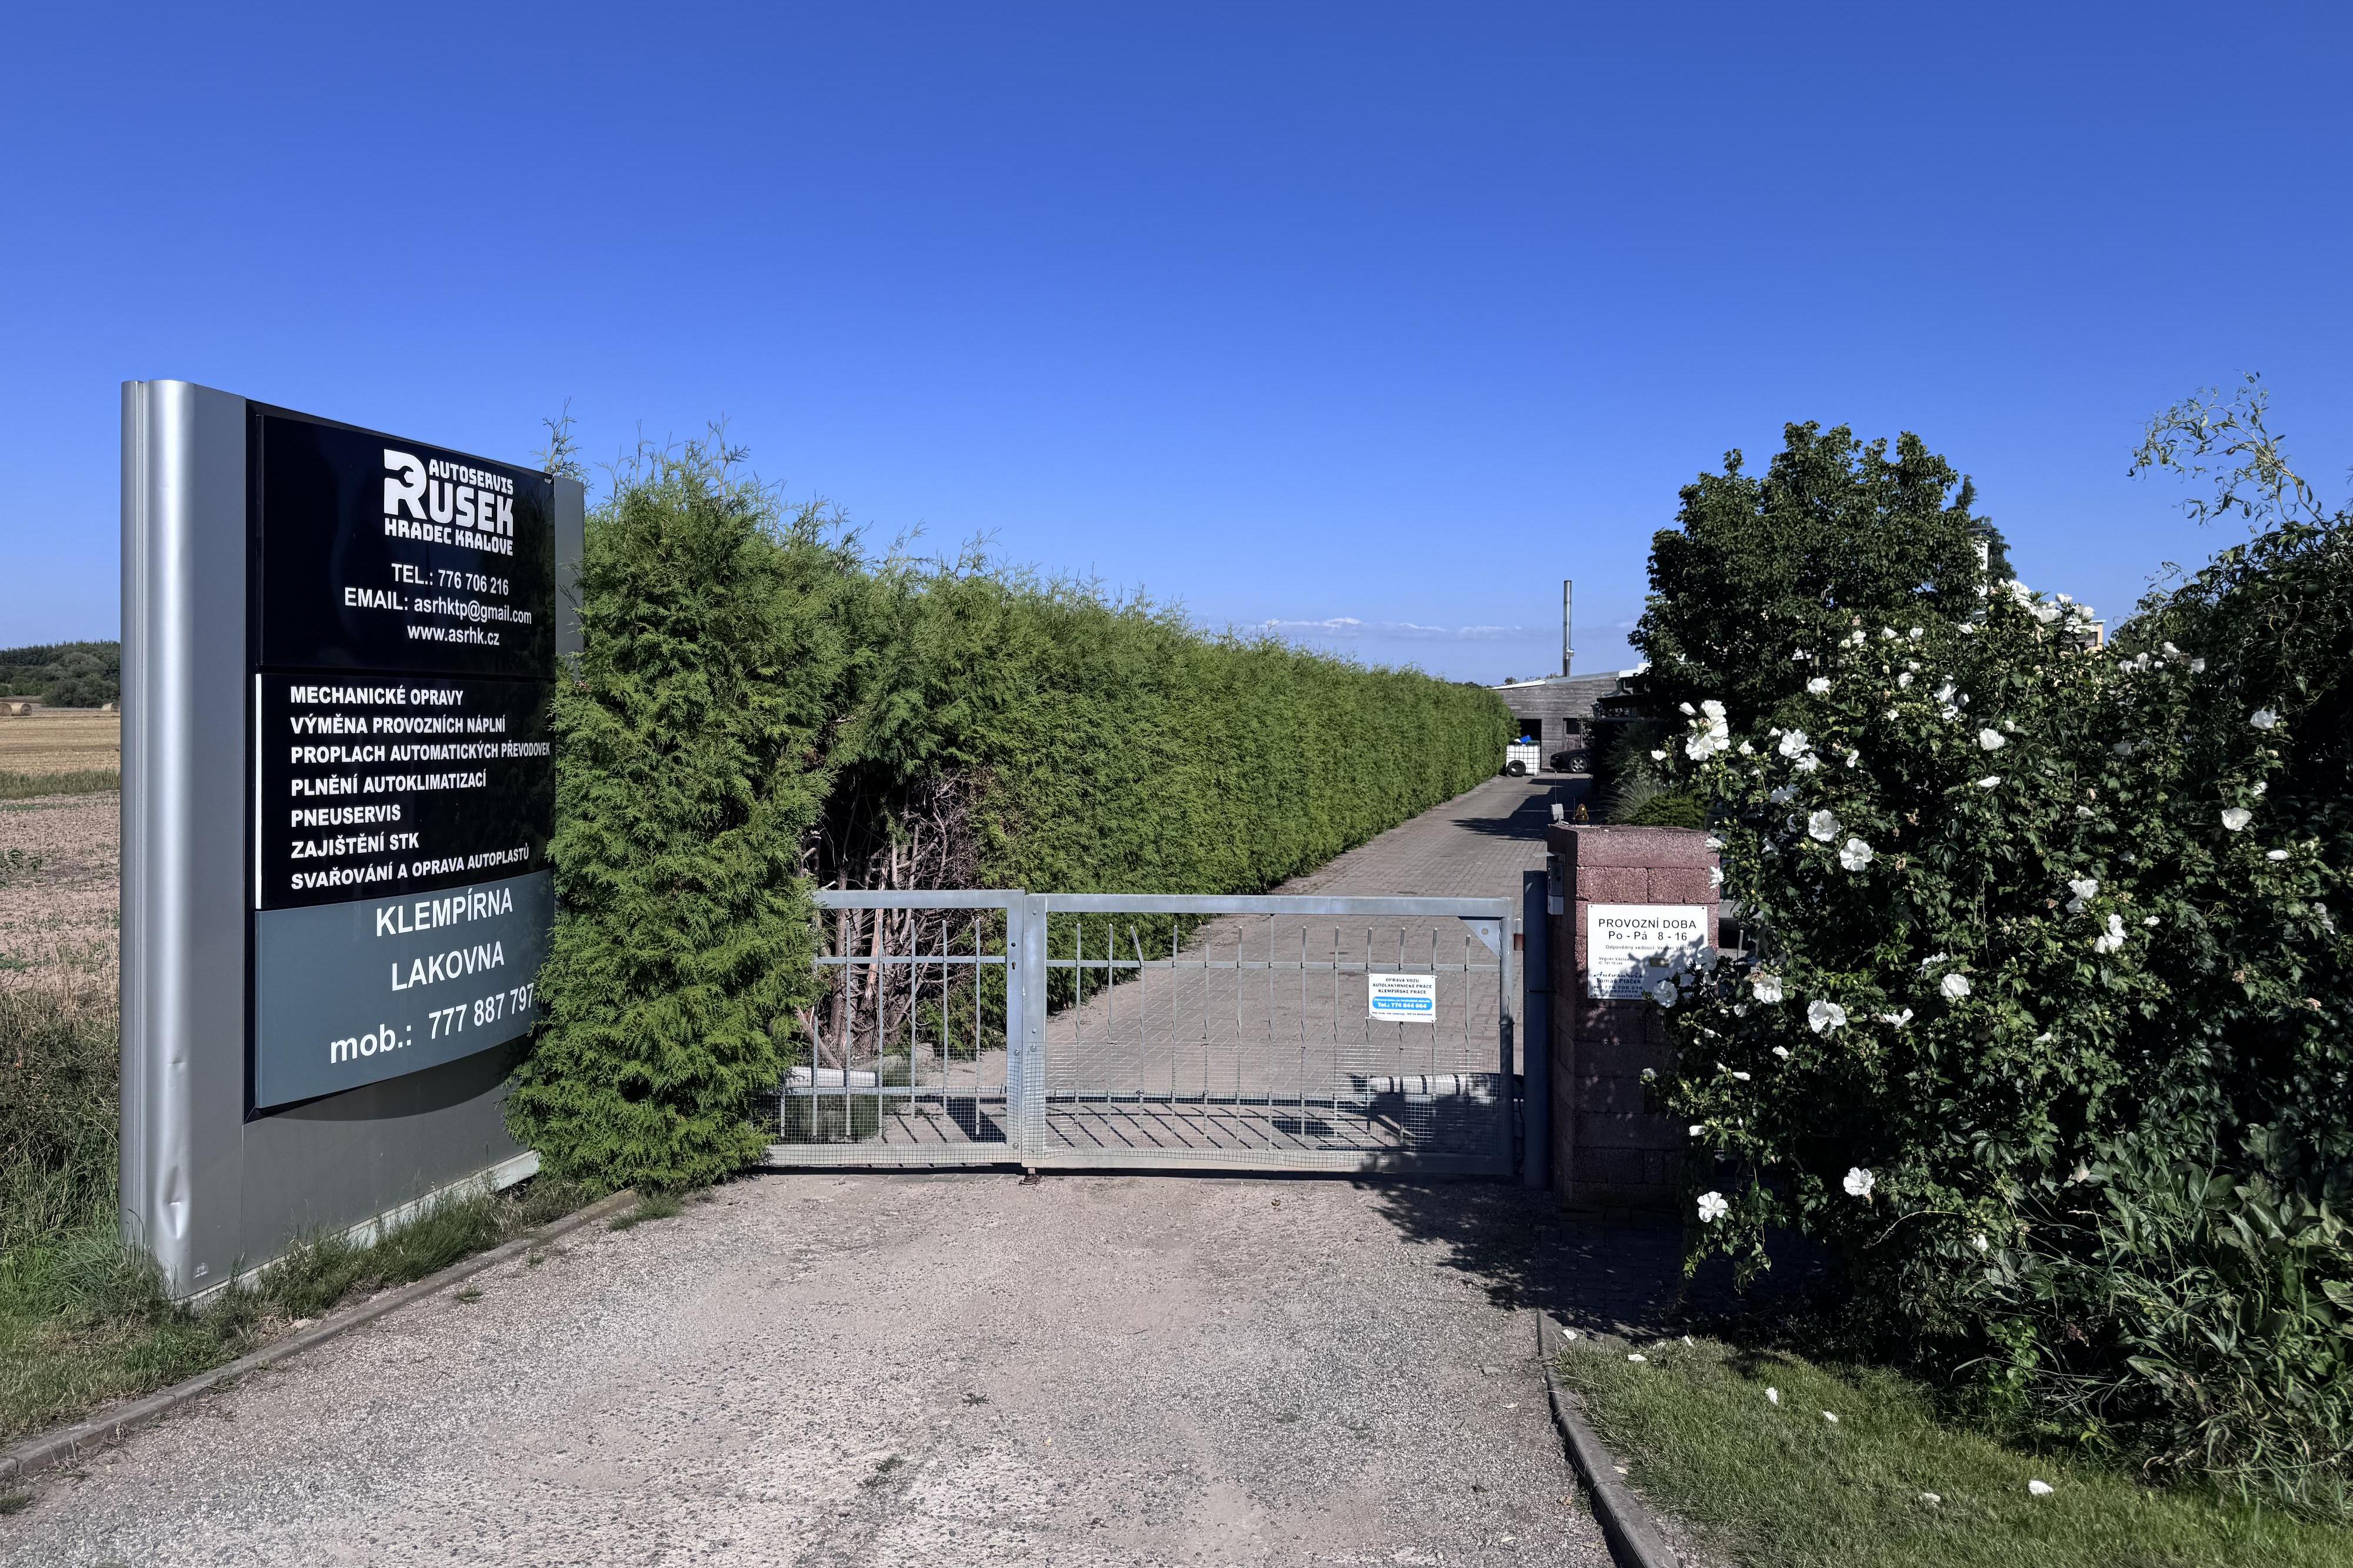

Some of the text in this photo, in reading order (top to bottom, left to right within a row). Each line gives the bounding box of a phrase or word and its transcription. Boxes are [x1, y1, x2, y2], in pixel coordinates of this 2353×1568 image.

[429, 459, 513, 495] AUTOSERVIS
[384, 449, 514, 536] RUSEK
[384, 518, 513, 556] HRADEC KRALOVE
[391, 563, 509, 596] TEL.: 776 706 216
[345, 587, 532, 624] EMAIL: asrhktp@gmail.com
[407, 625, 499, 646] www.asrhk.cz
[291, 685, 464, 705] MECHANICKÉ OPRAVY
[290, 713, 505, 734] VÝMĚNA PROVOZNÍCH NÁPLNÍ
[291, 740, 550, 764] PROPLACH AUTOMATICKÝCH PŘEVODOVEK
[291, 769, 487, 796] PLNĚNÍ AUTOKLIMATIZACÍ
[291, 804, 401, 827] PNEUSERVIS
[291, 832, 419, 859] ZAJIŠTĚNÍ STK
[291, 846, 529, 890] SVAŘOVÁNÍ A OPRAVA AUTOPLASTŮ
[376, 888, 513, 937] KLEMPÍRNA
[1599, 918, 1697, 929] PROVOZNÍ DOBA
[1609, 931, 1622, 940] Po
[1634, 931, 1647, 940] Pá
[1658, 932, 1664, 940] 8
[1675, 932, 1687, 940] 16
[391, 941, 505, 991] LAKOVNA
[330, 982, 535, 1064] mob.: 777 887 797
